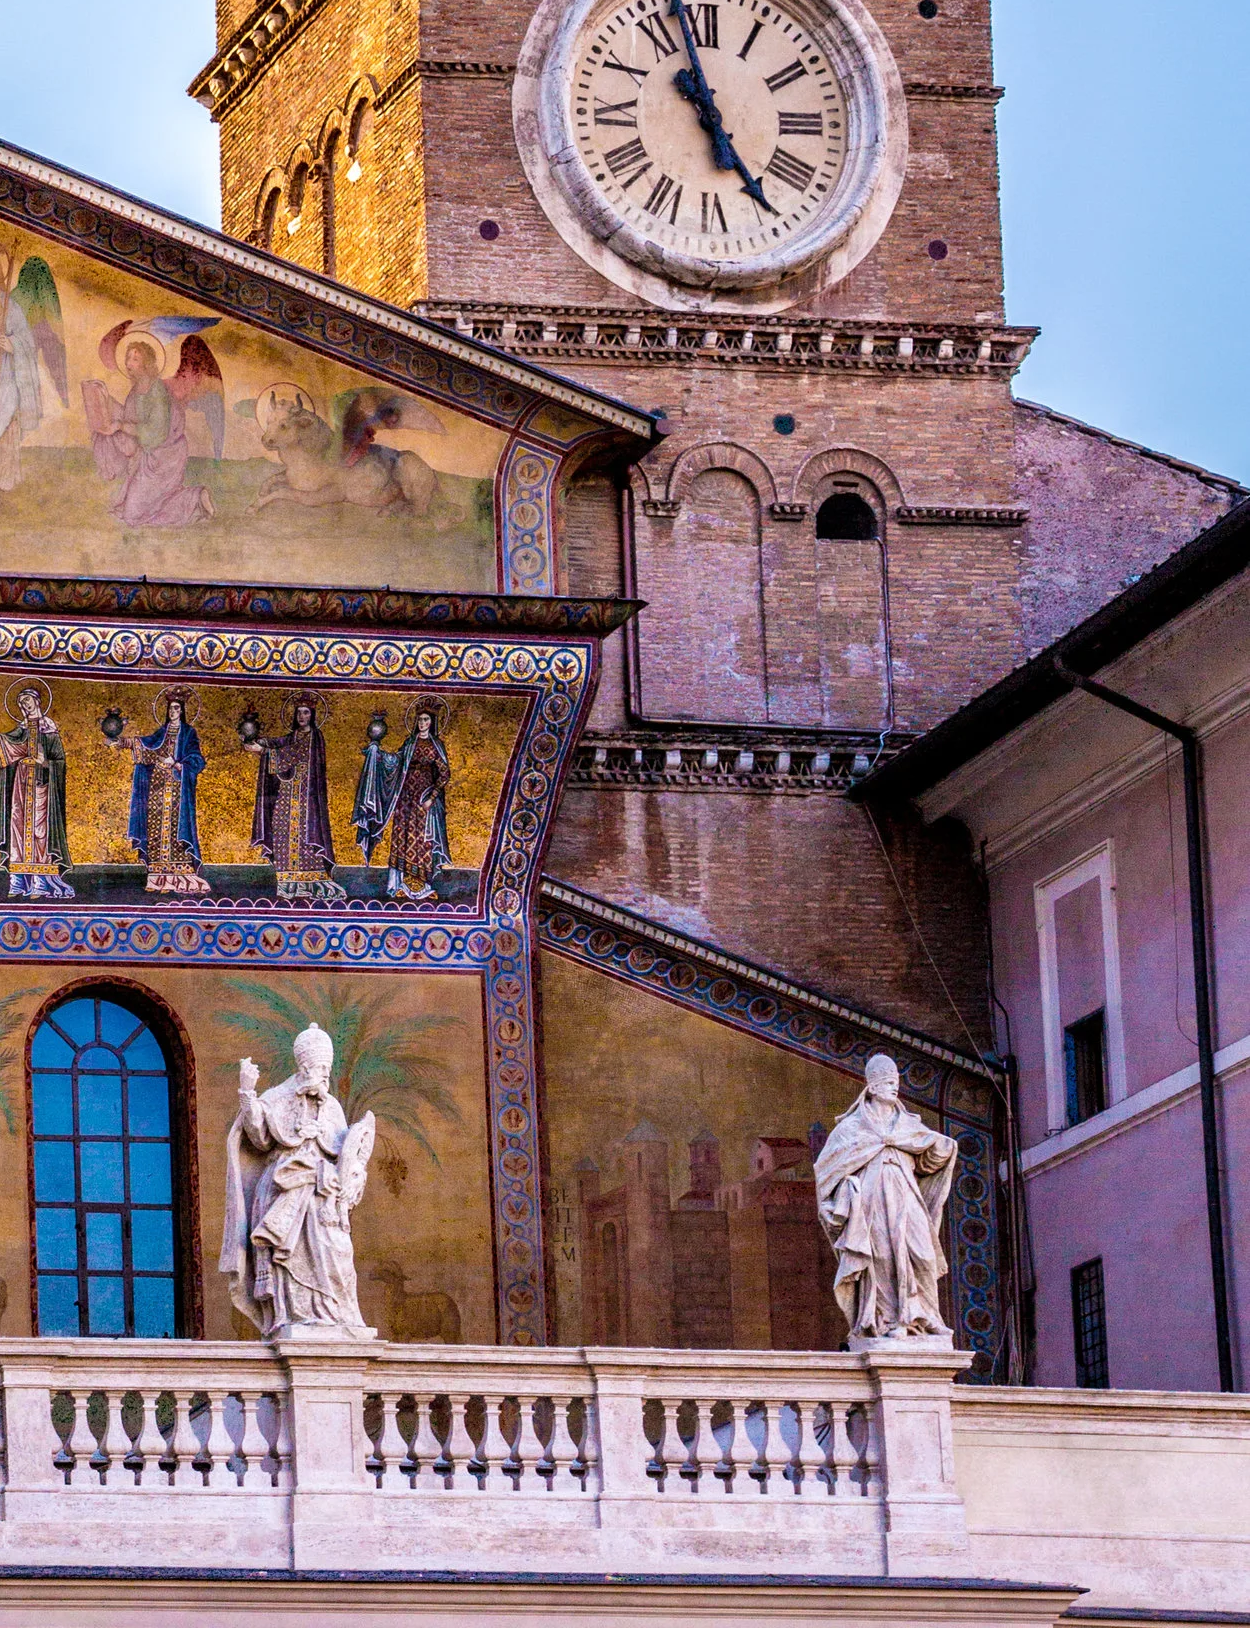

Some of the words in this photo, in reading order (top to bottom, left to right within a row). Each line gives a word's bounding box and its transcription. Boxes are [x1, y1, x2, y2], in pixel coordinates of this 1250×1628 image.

[635, 11, 680, 63] XI
[684, 3, 720, 50] XII
[736, 18, 765, 62] I
[602, 50, 650, 88] X
[762, 57, 809, 96] II
[594, 96, 638, 128] IX
[777, 110, 823, 137] III
[602, 135, 654, 192] VIII
[764, 145, 817, 195] IIII
[643, 173, 683, 226] VII
[700, 191, 730, 234] VI
